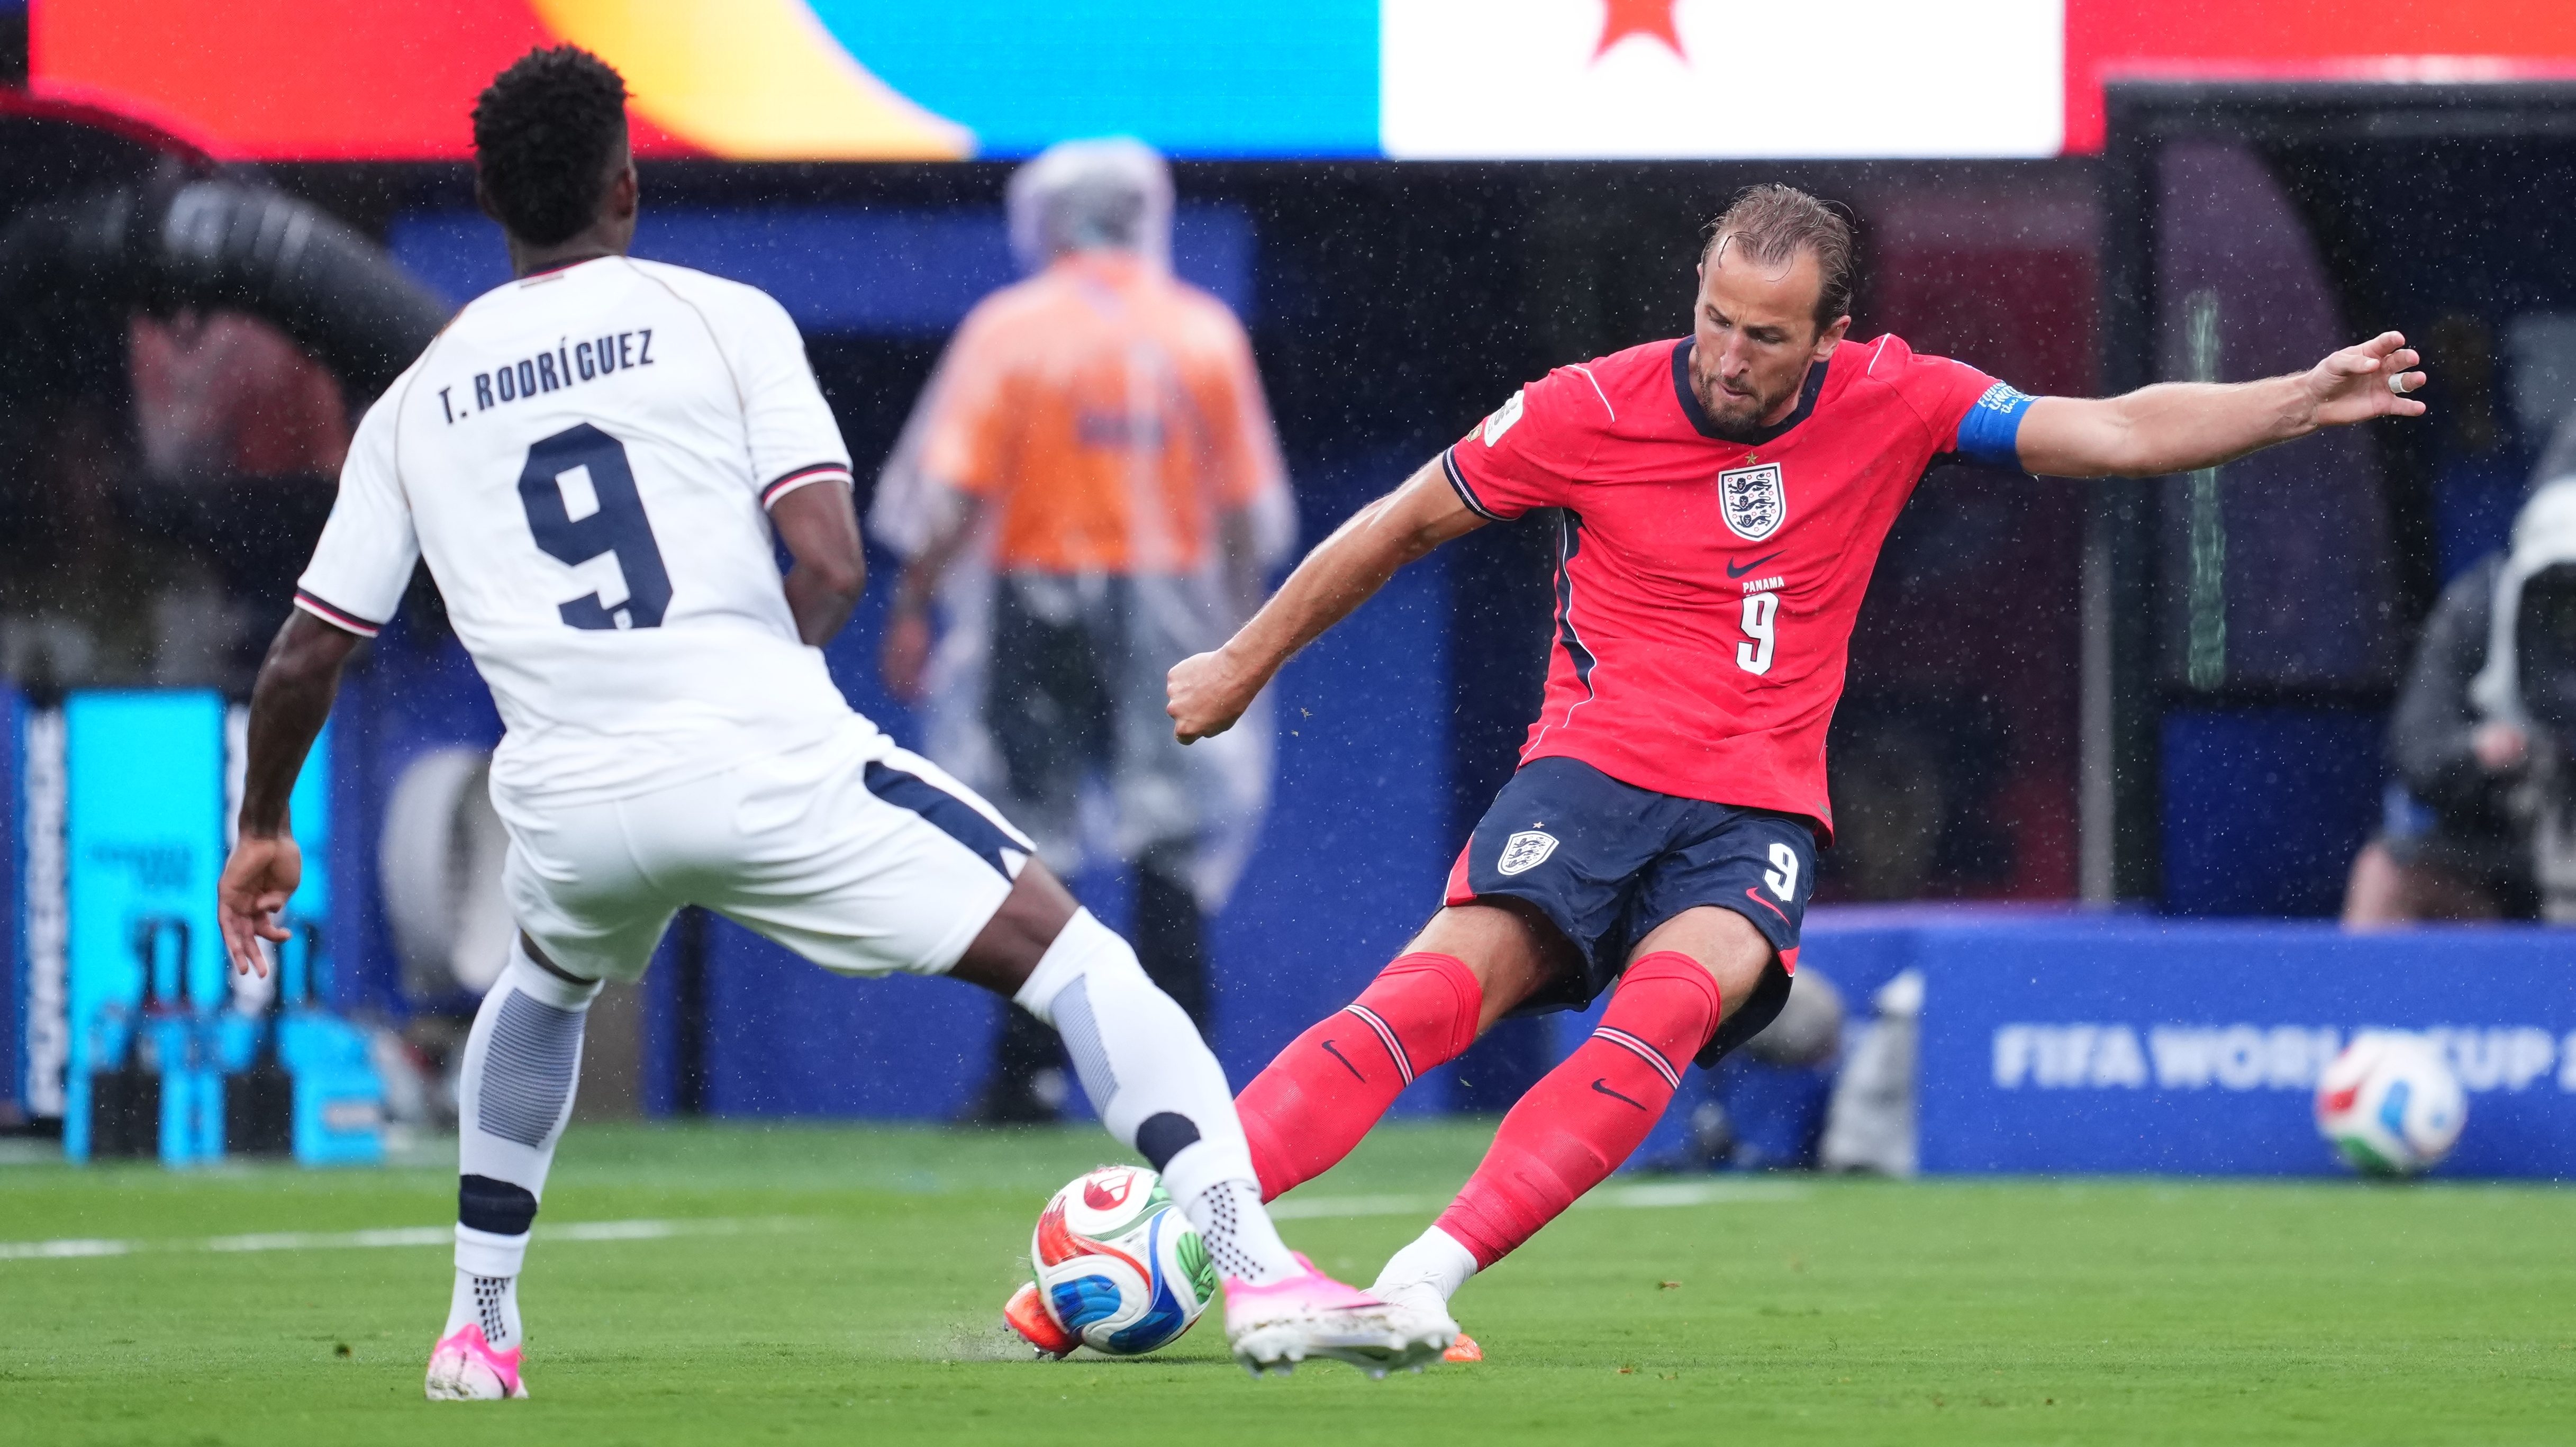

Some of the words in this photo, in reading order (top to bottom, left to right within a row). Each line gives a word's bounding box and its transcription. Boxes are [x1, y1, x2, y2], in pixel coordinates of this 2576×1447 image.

[438, 386, 467, 424] T.
[475, 329, 654, 411] RODRÍGUEZ
[517, 422, 673, 630] 9
[1743, 576, 1784, 593] PANAMA
[1736, 591, 1779, 676] 9
[1763, 843, 1799, 903] 9
[1994, 1025, 2147, 1088] FIFA
